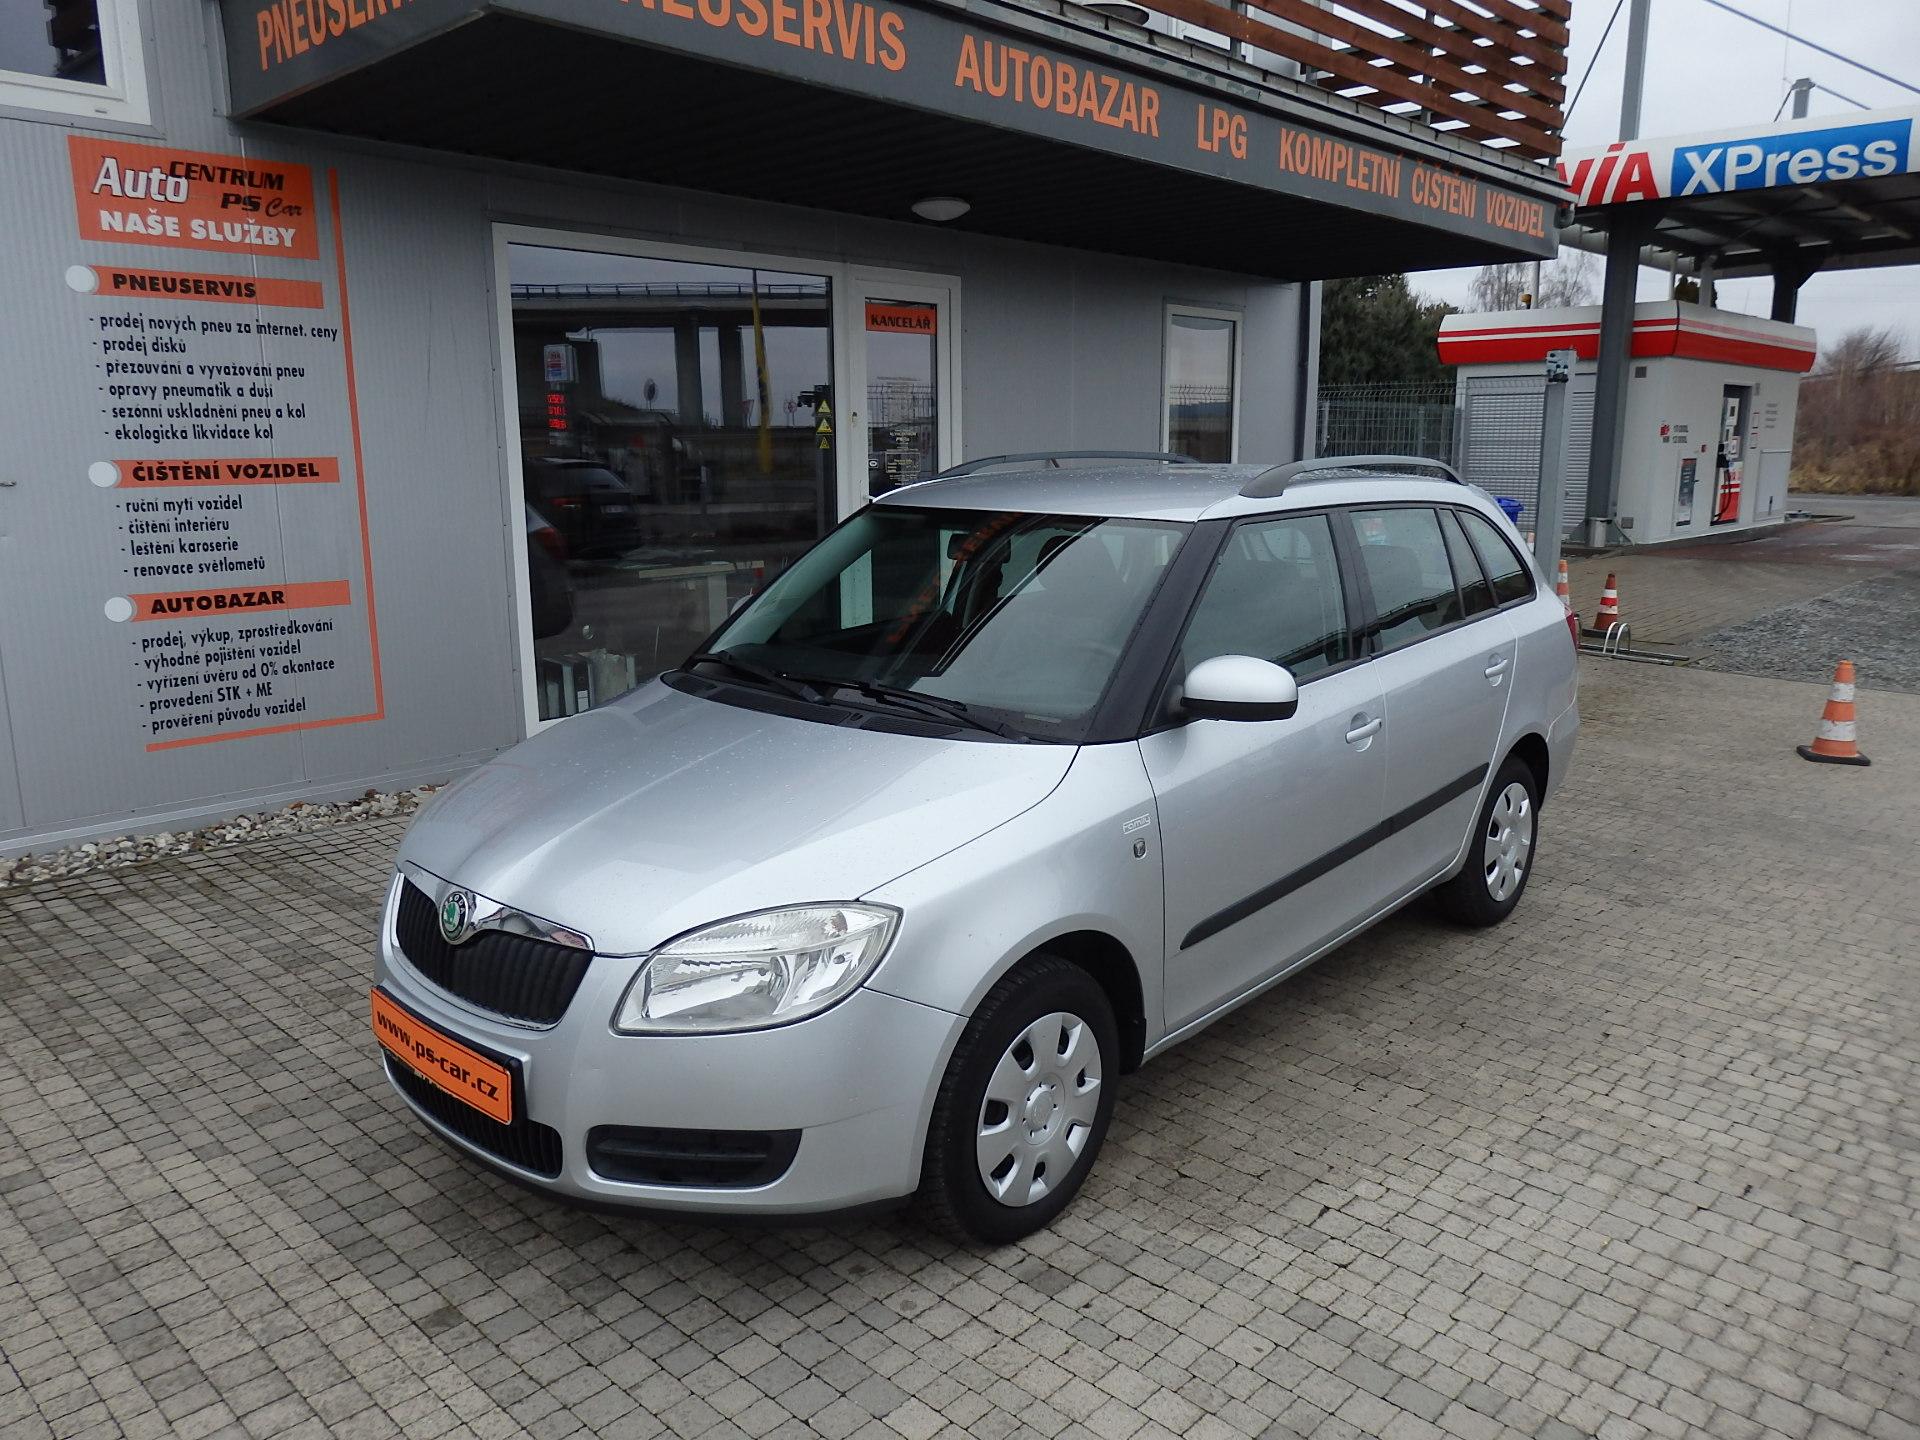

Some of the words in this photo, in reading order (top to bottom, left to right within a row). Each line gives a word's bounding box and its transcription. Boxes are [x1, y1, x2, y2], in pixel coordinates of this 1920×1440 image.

[955, 34, 1159, 137] AUTOBAZAR
[1197, 103, 1248, 159] LPG
[1279, 127, 1403, 199] KOMPLETNÍ
[1411, 158, 1479, 218] ČIŠTĚNÍ
[1486, 189, 1545, 238] VOZIDEL
[1680, 140, 1897, 196] XPress
[92, 156, 188, 203] Auto
[169, 161, 285, 190] CENTRUM
[221, 193, 262, 211] PS
[266, 198, 302, 217] Car
[100, 208, 180, 237] NAŠE
[191, 219, 296, 247] SLUŽBY
[113, 273, 256, 298] PNEUSERVIS
[100, 313, 145, 332] prodej
[202, 322, 232, 334] pneu
[237, 323, 251, 334] za
[256, 320, 306, 337] internet.
[311, 327, 338, 342] ceny
[871, 314, 931, 330] KANCELÁŘ
[103, 338, 147, 355] prodej
[186, 366, 193, 375] a
[277, 367, 304, 379] pneu
[110, 384, 157, 400] opravy
[163, 383, 231, 398] pneumatik
[237, 387, 244, 397] a
[242, 407, 270, 420] pneu
[276, 408, 282, 418] a
[287, 404, 305, 418] kol
[193, 424, 250, 439] likvidace
[254, 424, 273, 439] kol
[132, 460, 220, 482] ČIŠTĚNÍ
[227, 462, 319, 479] VOZIDEL
[126, 498, 158, 512] ruční
[198, 494, 242, 510] vozidel
[179, 536, 238, 553] karoserie
[134, 562, 193, 577] renovace
[151, 590, 285, 614] AUTOBAZAR
[142, 632, 186, 652] prodej,
[260, 640, 301, 656] vozidel
[242, 664, 257, 678] od
[261, 662, 278, 677] 0%
[282, 658, 335, 675] akontace
[150, 691, 213, 713] provedení
[217, 686, 241, 702] STK
[256, 682, 272, 697] ME
[265, 698, 306, 717] vozidel
[376, 1011, 499, 1101] www.ps-car.cz
